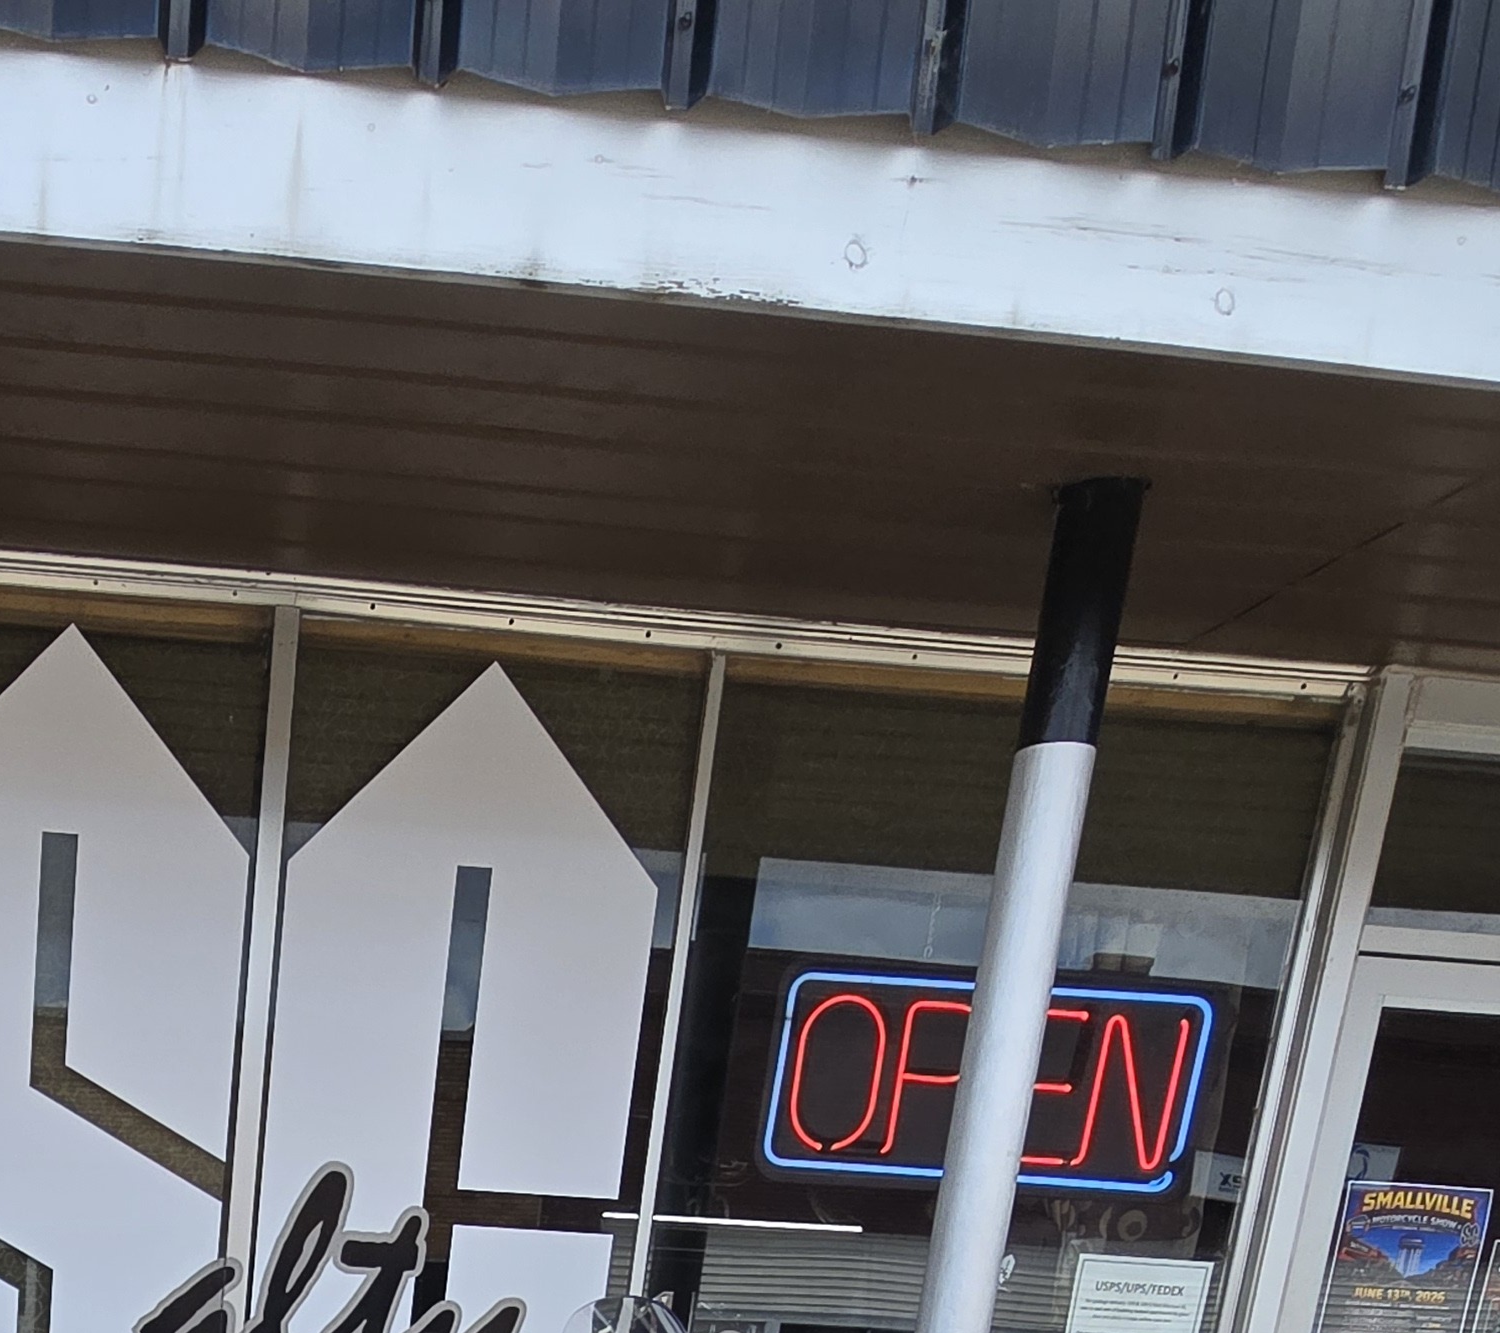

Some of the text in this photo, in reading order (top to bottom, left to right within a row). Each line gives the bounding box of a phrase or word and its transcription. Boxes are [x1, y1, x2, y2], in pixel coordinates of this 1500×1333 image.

[1362, 1190, 1475, 1220] SMALLVILLE
[1372, 1213, 1428, 1225] MOTORCYCLE
[1430, 1216, 1458, 1229] SHOW
[1095, 1280, 1186, 1297] USPS/UPS/FEDEX
[1353, 1287, 1384, 1299] JUNE
